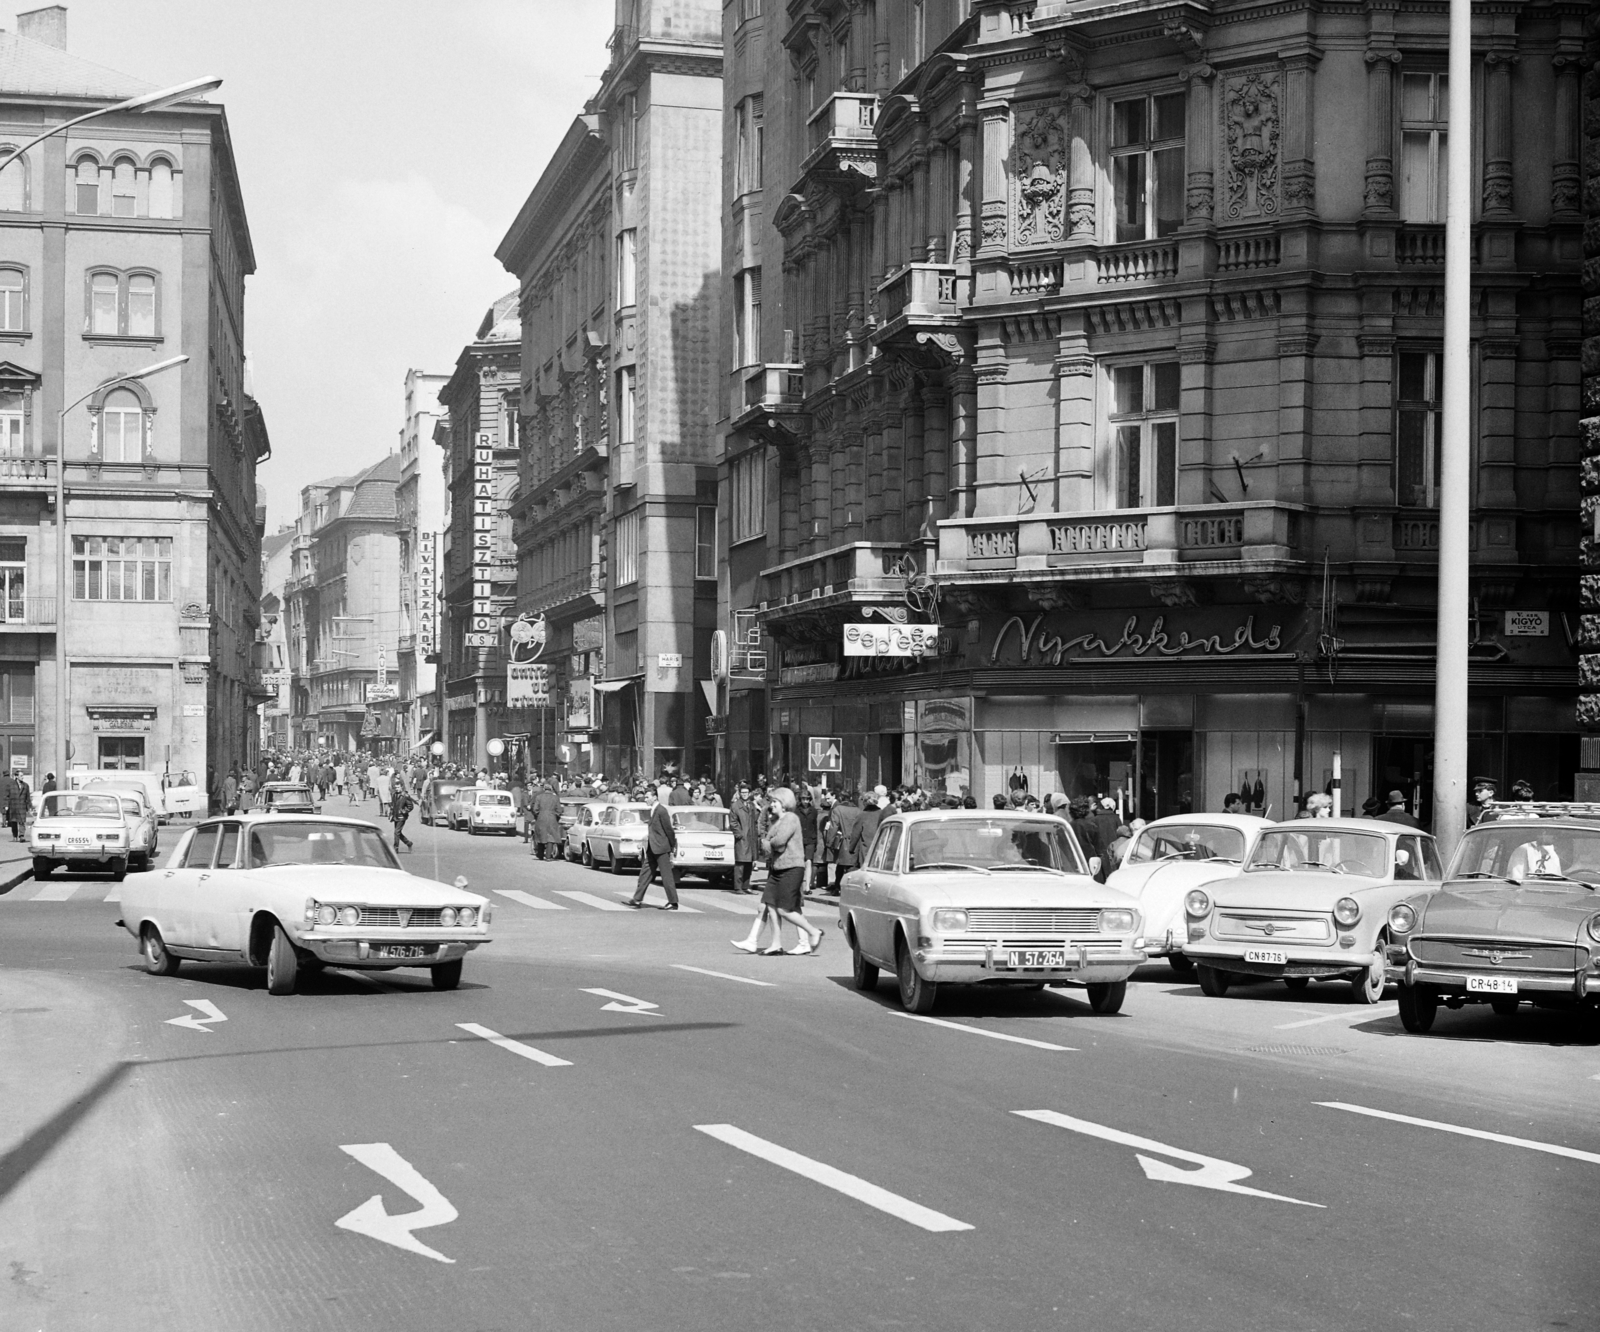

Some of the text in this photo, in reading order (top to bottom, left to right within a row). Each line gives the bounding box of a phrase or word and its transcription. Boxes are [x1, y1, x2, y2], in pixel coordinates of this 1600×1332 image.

[421, 532, 431, 654] DIVATSZALON
[477, 434, 490, 630] RUHATISZTITO
[1010, 951, 1019, 966] N
